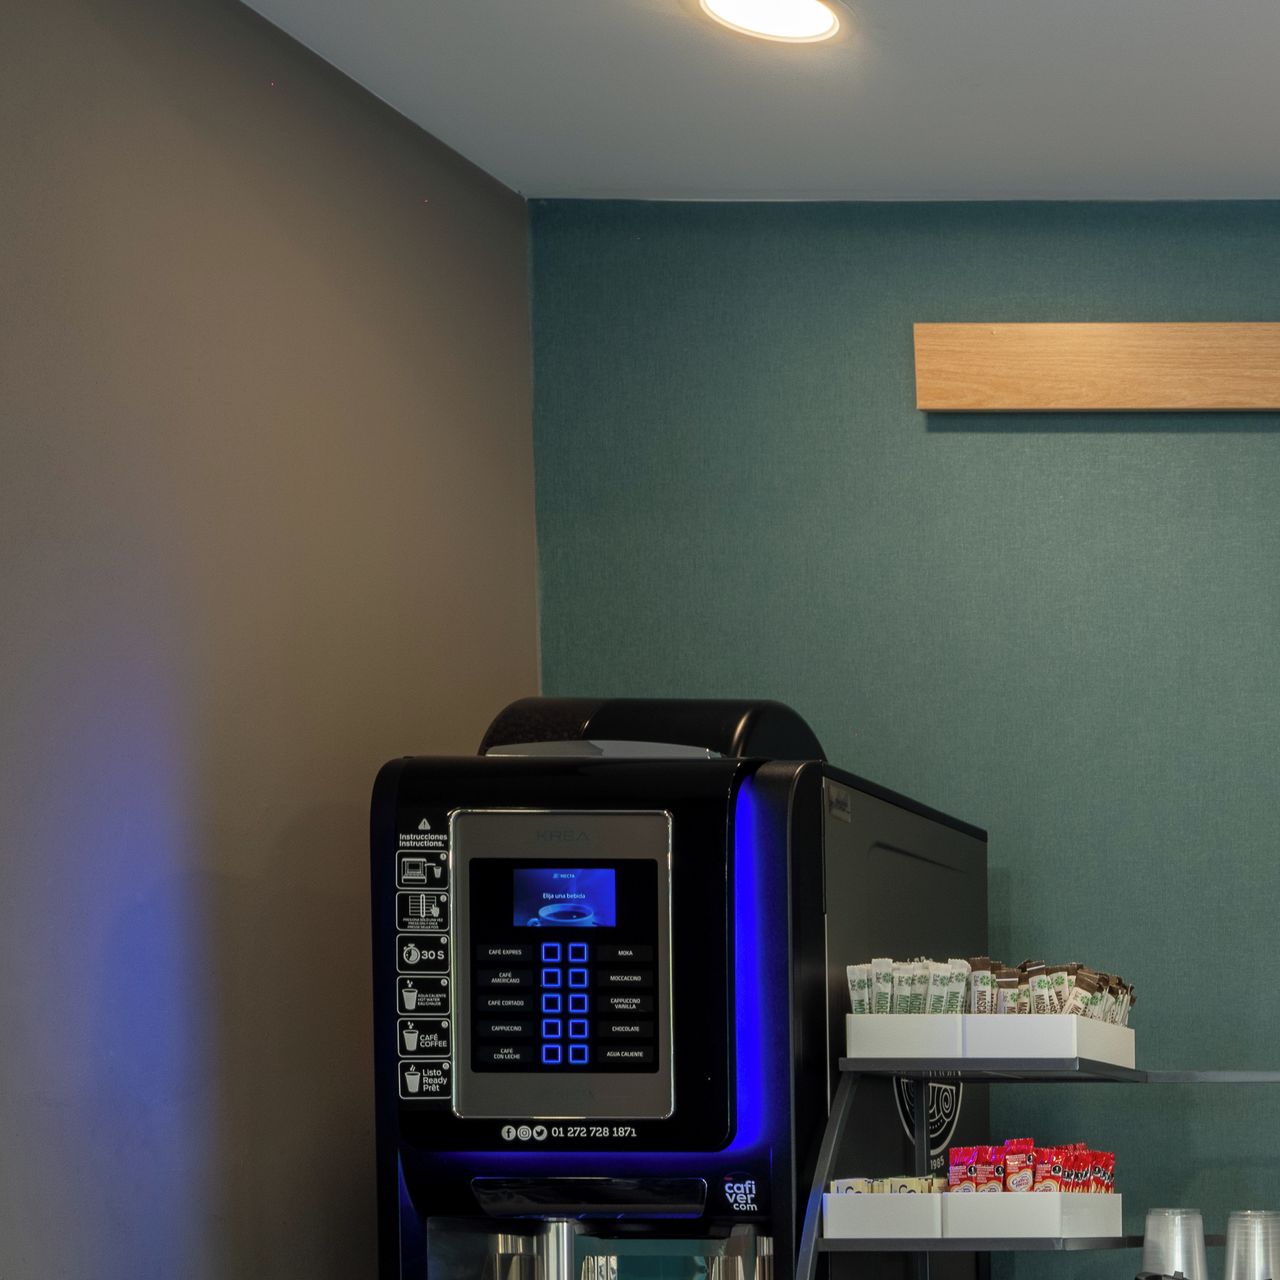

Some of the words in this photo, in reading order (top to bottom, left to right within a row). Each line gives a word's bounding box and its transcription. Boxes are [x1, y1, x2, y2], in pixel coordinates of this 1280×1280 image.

[399, 833, 448, 841] Instrucciones
[536, 830, 591, 841] KREA
[399, 840, 445, 848] Instructions.
[566, 892, 586, 900] bebida
[421, 951, 436, 960] 30
[437, 951, 445, 960] S
[420, 1033, 438, 1041] CAFÉ
[420, 1040, 448, 1048] COFFEE
[422, 1076, 448, 1085] Ready
[422, 1084, 440, 1092] Prêt
[551, 1126, 565, 1137] 01
[567, 1126, 587, 1137] 272
[589, 1126, 610, 1137] 728
[612, 1126, 637, 1137] 1871
[930, 1156, 945, 1171] 1985
[724, 1180, 756, 1194] cafi
[725, 1193, 755, 1204] ver
[733, 1203, 758, 1212] com
